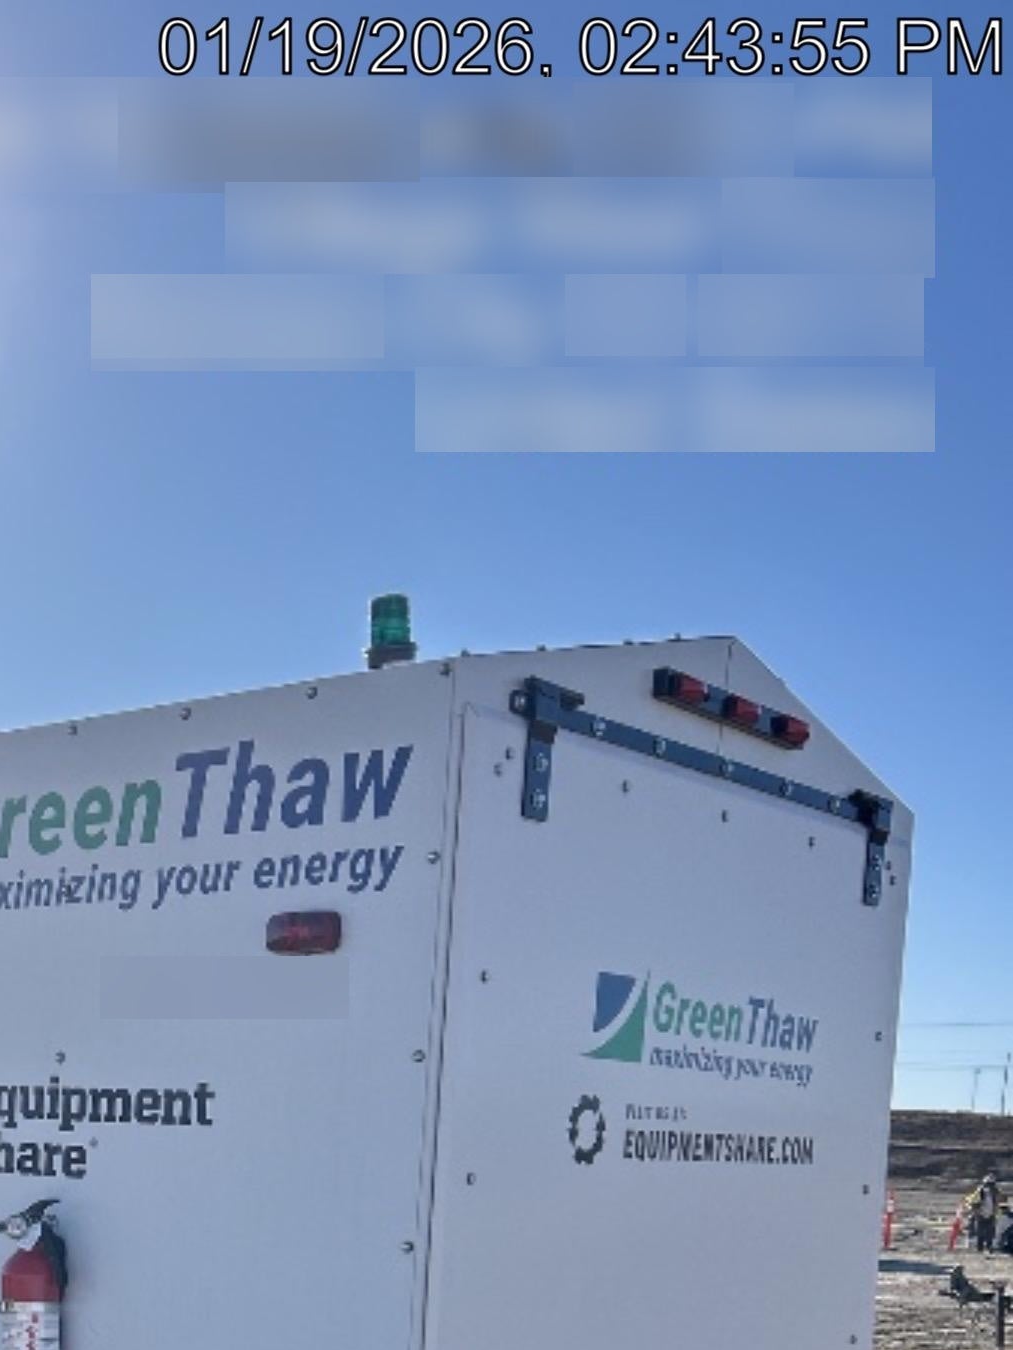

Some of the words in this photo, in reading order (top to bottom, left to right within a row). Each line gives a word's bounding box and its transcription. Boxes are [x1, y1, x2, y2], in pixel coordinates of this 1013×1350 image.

[152, 859, 242, 909] your
[253, 844, 405, 894] energy
[622, 1127, 814, 1165] EQUIPMENTSHARE.COM
